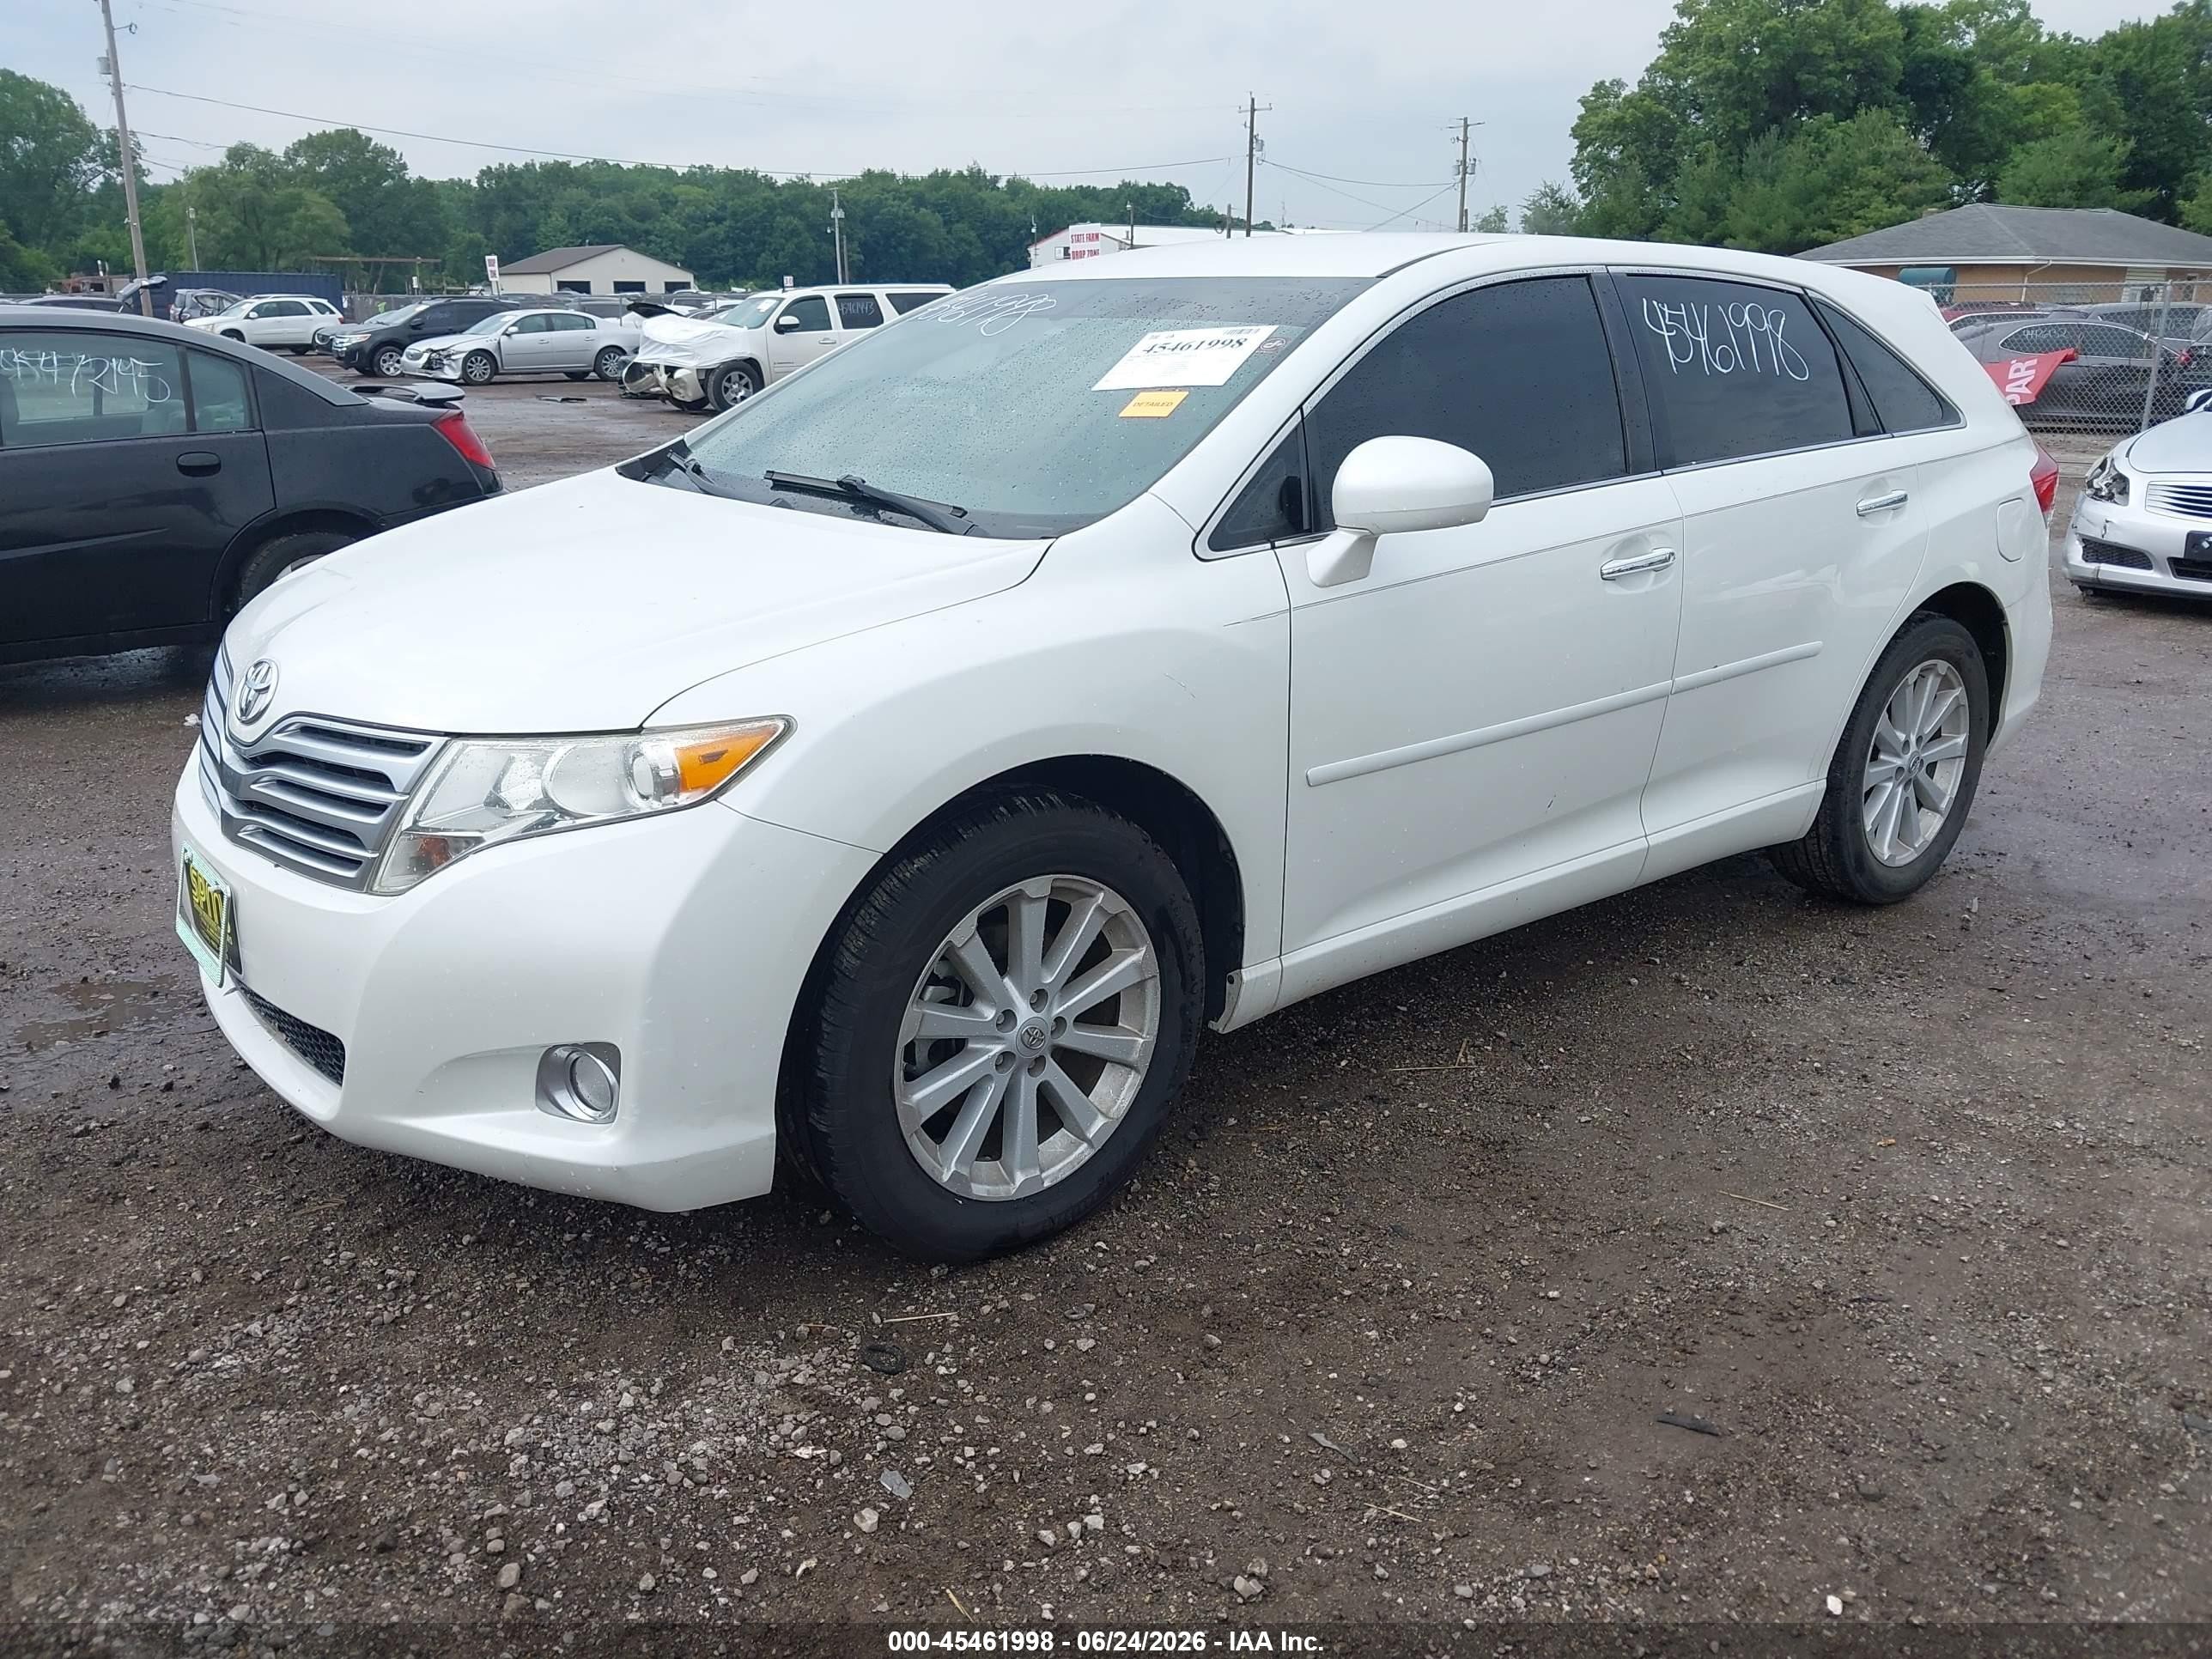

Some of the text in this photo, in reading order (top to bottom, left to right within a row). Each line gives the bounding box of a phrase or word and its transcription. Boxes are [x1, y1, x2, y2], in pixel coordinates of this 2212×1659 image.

[1071, 233, 1099, 244] STATE FARM
[1072, 250, 1086, 260] DROP
[1142, 337, 1248, 354] 45461998
[1643, 297, 1809, 380] 45461998
